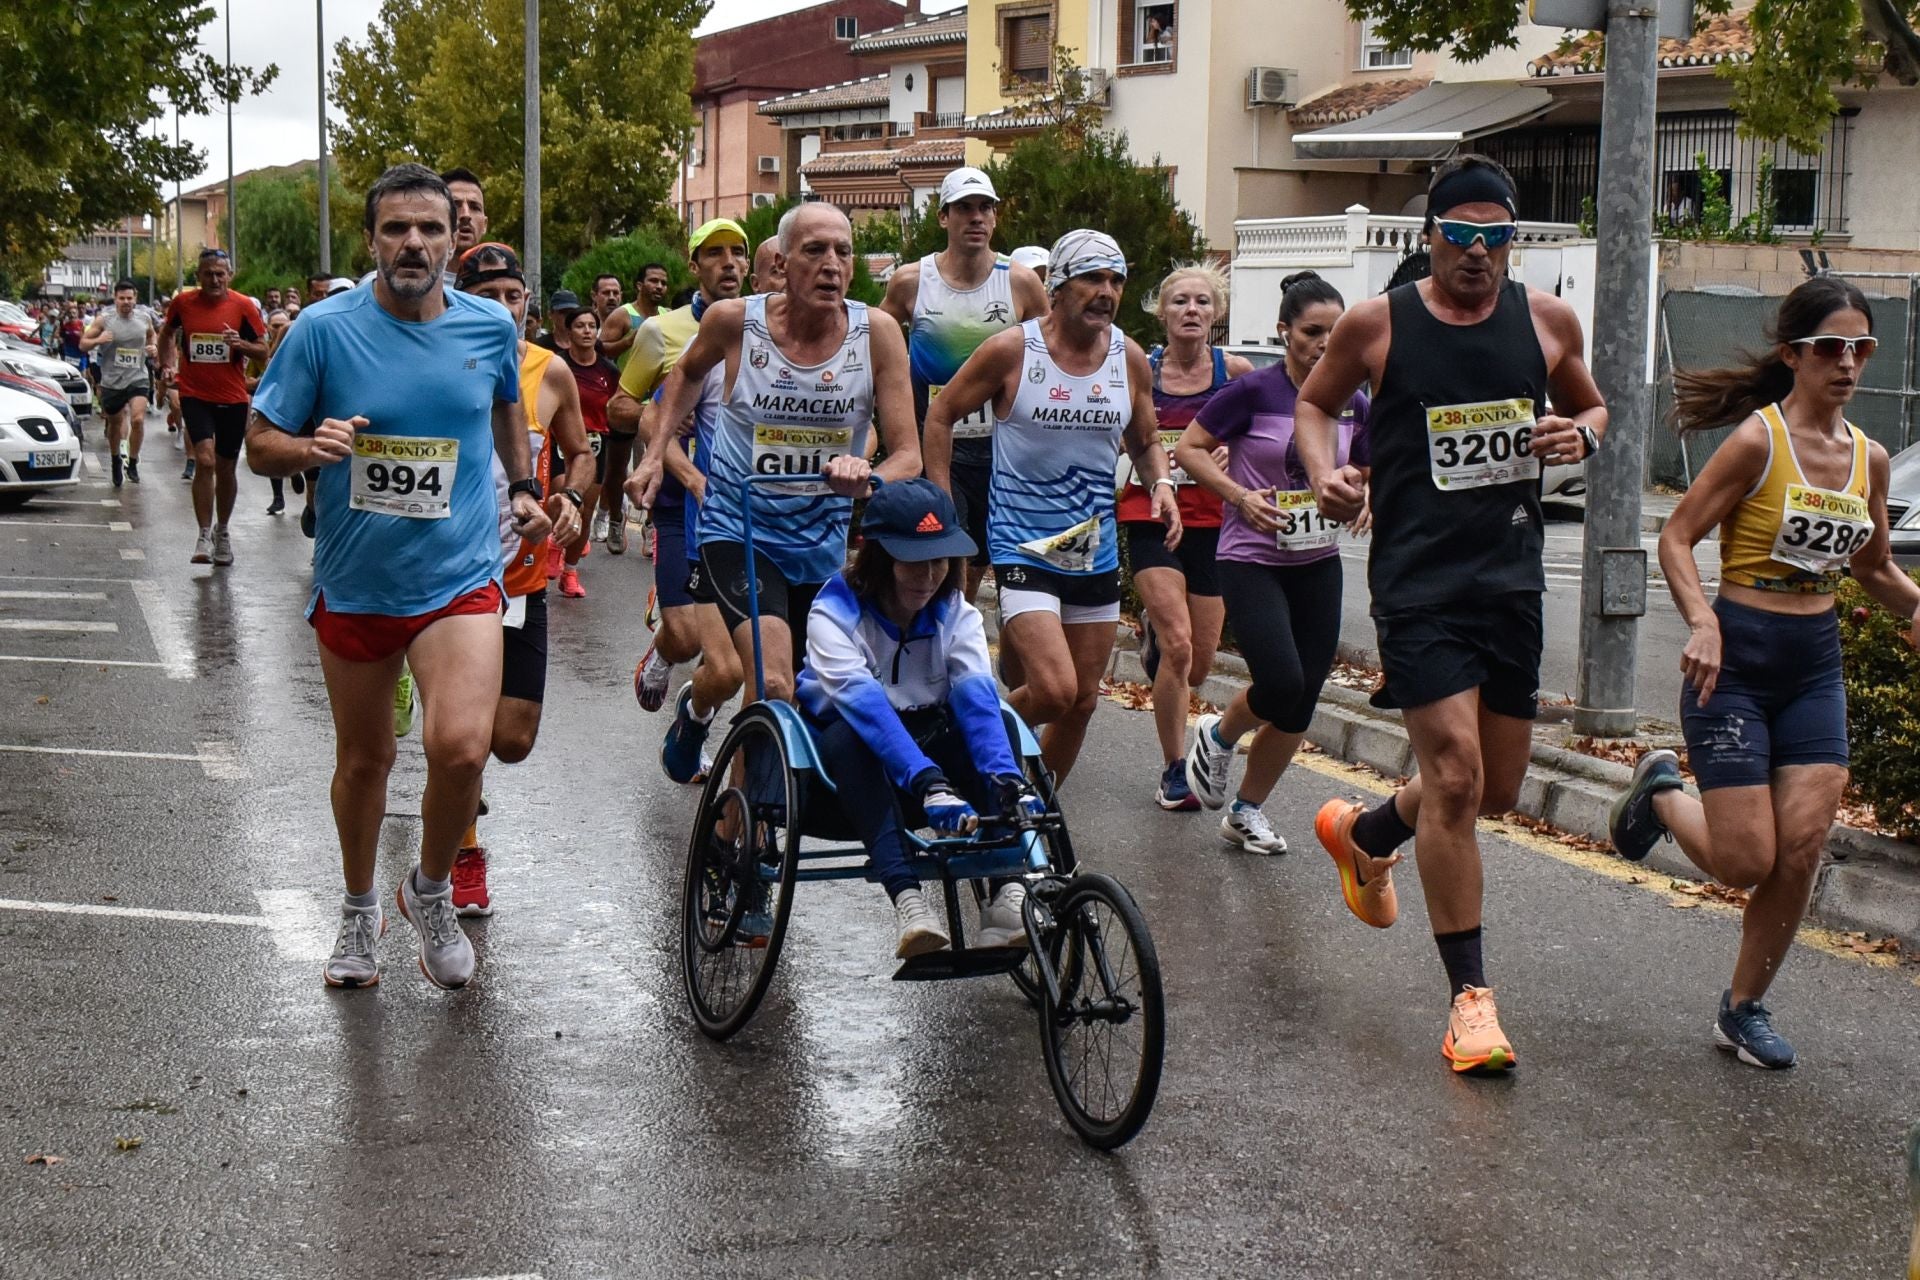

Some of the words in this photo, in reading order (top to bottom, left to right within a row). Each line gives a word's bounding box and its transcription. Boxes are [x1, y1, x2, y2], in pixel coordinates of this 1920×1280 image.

[196, 343, 224, 356] 885
[119, 355, 137, 364] 301
[752, 393, 855, 415] MARACENA
[1031, 407, 1121, 425] MARACENA
[1443, 410, 1462, 425] 38
[1462, 408, 1517, 425] FONDO
[767, 428, 783, 440] 38
[783, 433, 832, 445] FONDO
[366, 439, 382, 453] 38
[382, 443, 437, 457] FONDO
[1434, 426, 1535, 469] 3206
[35, 453, 56, 466] 5290
[756, 449, 840, 475] GUÍ
[366, 462, 442, 497] 994
[1803, 492, 1822, 508] 38
[1820, 500, 1862, 516] FONDO
[1782, 515, 1870, 556] 3286
